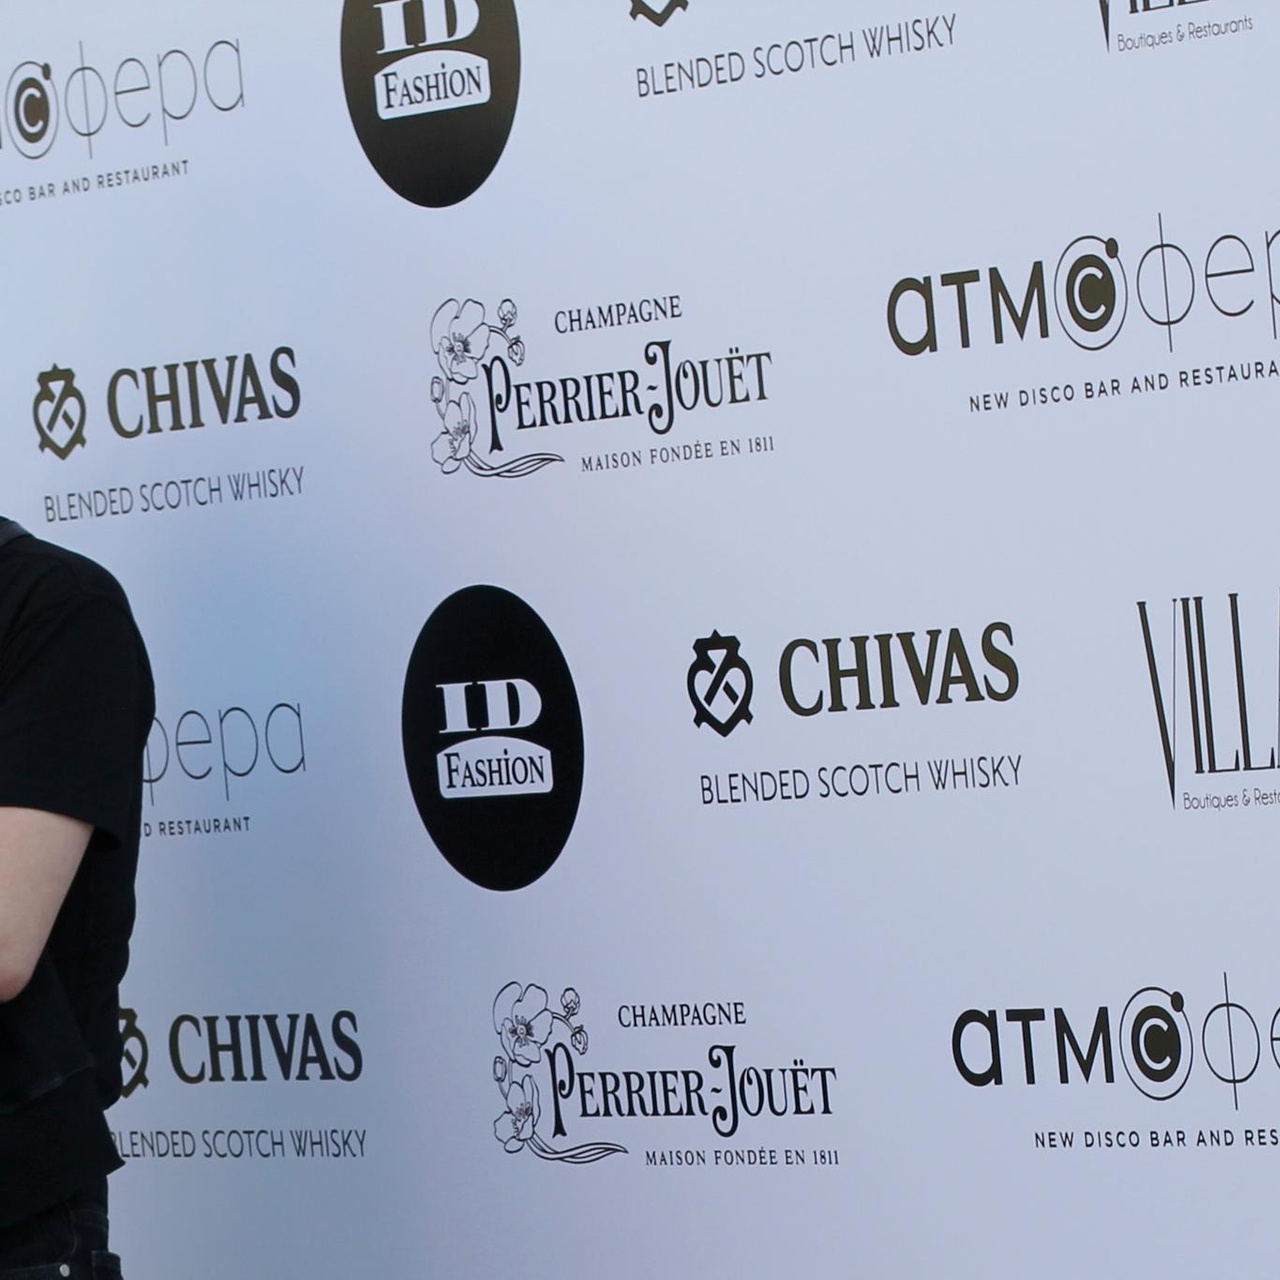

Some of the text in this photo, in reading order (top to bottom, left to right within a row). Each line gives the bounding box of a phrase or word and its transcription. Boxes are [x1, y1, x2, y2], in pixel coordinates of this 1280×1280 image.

[1118, 16, 1253, 51] Boutiques & Restaurants
[637, 13, 956, 97] BLENDED SCOTCH WHISKY
[29, 183, 55, 200] BAR
[63, 177, 90, 194] AND
[97, 160, 188, 188] RESTAURANT
[555, 295, 682, 333] CHAMPAGNE
[107, 346, 300, 438] CHIVAS
[970, 392, 1008, 412] NEW
[1019, 385, 1074, 406] DISCO
[1085, 379, 1120, 398] BAR
[1131, 373, 1168, 393] AND
[582, 436, 774, 472] MAISON FONDÉE EN 1811
[45, 466, 303, 522] BLENDED SCOTCH WHISKY
[779, 622, 1019, 716] CHIVAS
[435, 678, 543, 734] ID
[1136, 587, 1280, 810] VILL
[701, 755, 1021, 804] BLENDED SCOTCH WHISKY
[1183, 792, 1238, 810] Boutiques
[1242, 789, 1250, 806] &
[159, 817, 250, 835] RESTAURANT
[618, 1002, 746, 1027] CHAMPAGNE
[169, 1010, 362, 1084] CHIVAS
[202, 1130, 285, 1158] SCOTCH
[290, 1129, 366, 1158] WHISKY
[646, 1147, 838, 1165] MAISON FONDÉE EN 1811
[1035, 1132, 1073, 1147] NEW
[1084, 1131, 1139, 1147] DISCO
[1150, 1131, 1186, 1147] BAR
[1197, 1130, 1234, 1146] AND
